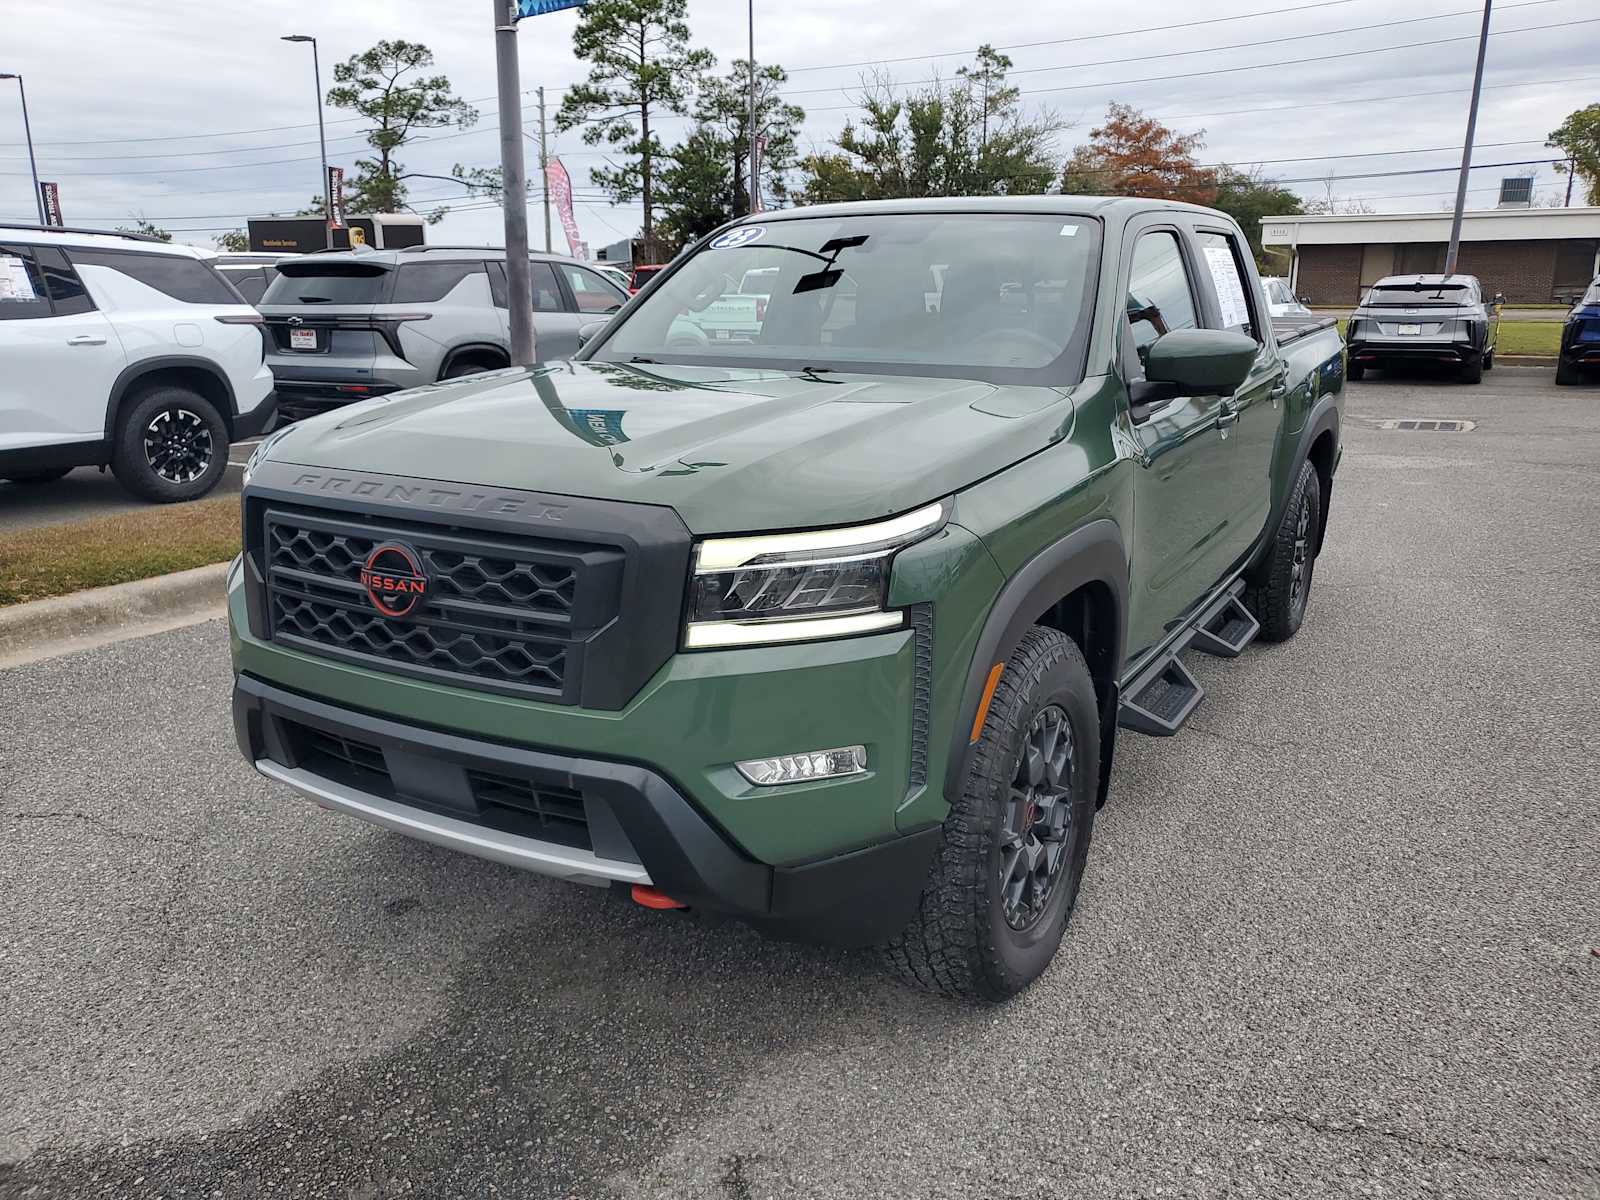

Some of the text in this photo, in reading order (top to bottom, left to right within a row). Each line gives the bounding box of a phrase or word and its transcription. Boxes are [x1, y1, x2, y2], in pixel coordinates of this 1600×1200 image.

[45, 185, 56, 214] TRUCKS
[331, 170, 339, 204] TRUCKS
[292, 474, 568, 521] FRONTIER
[361, 572, 425, 593] NISSAN
